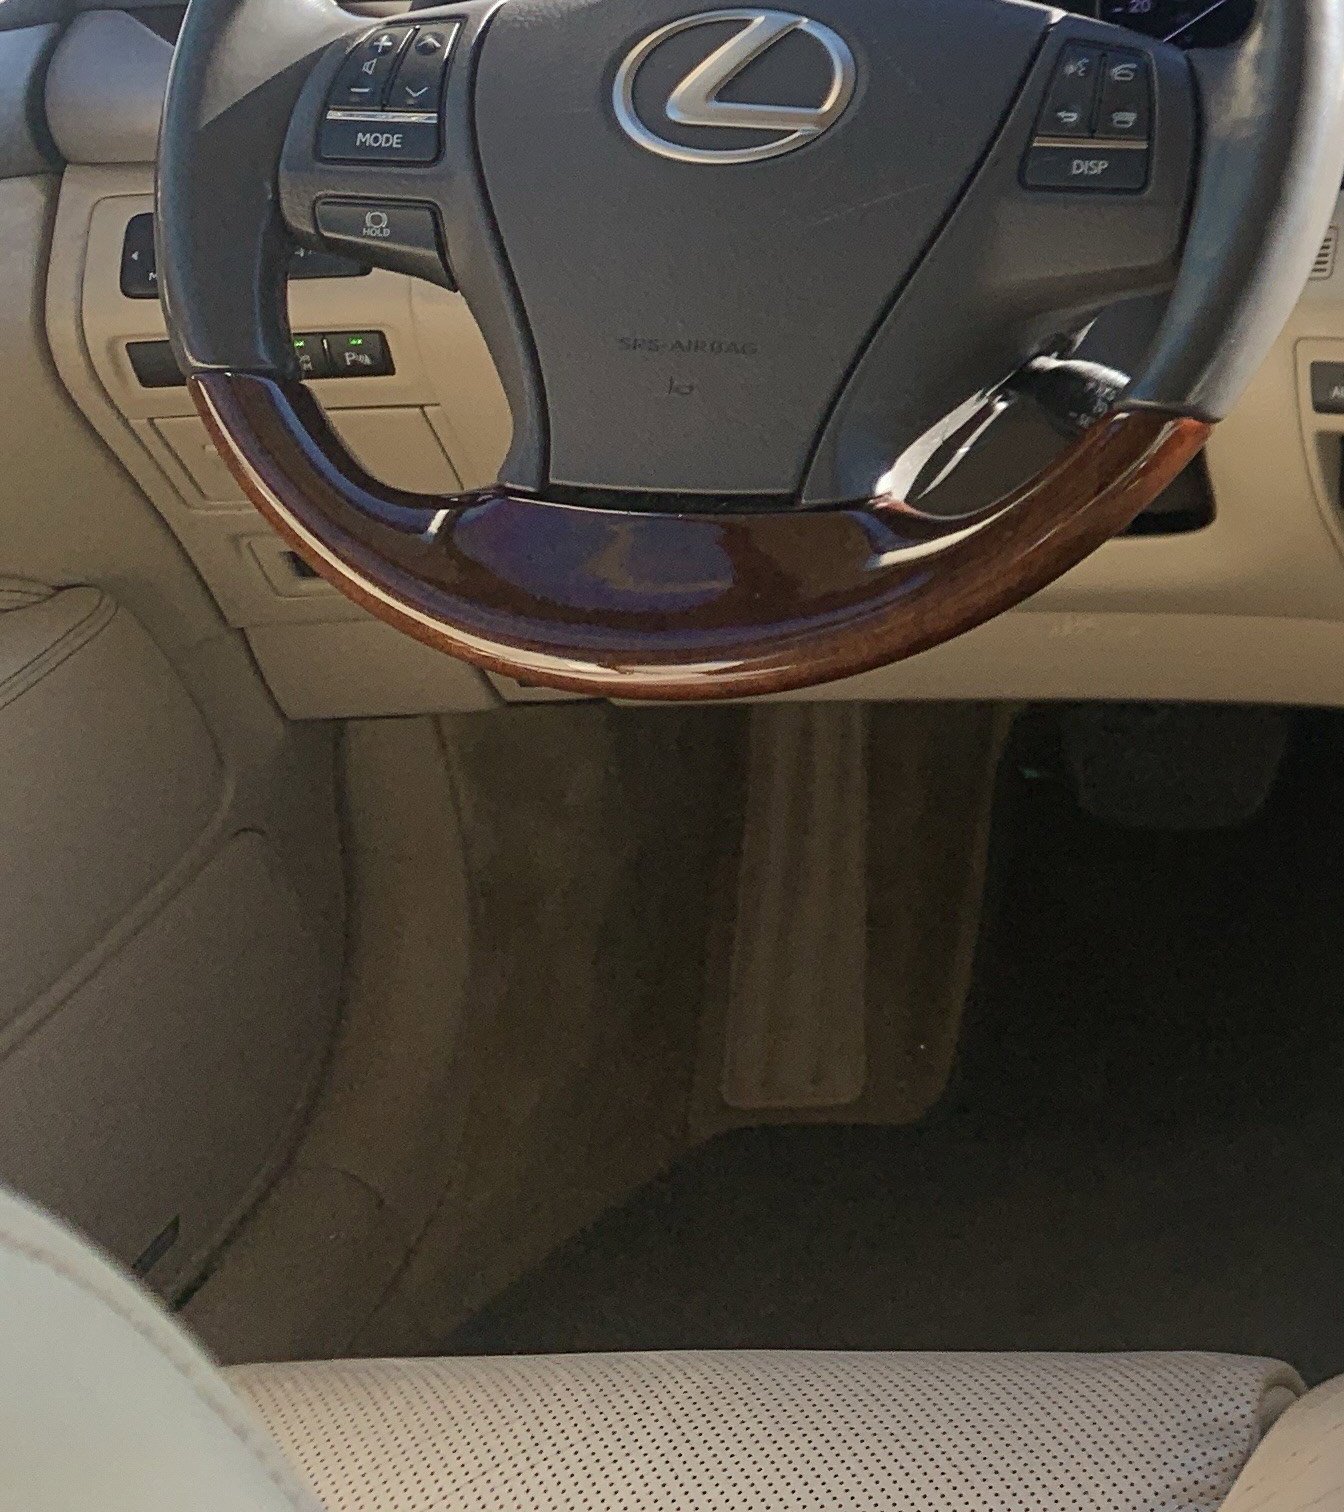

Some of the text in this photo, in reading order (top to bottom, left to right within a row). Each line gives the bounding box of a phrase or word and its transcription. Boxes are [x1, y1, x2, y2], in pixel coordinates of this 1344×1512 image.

[355, 132, 403, 148] MODE
[1071, 158, 1109, 176] DISP
[362, 227, 391, 237] HOLD
